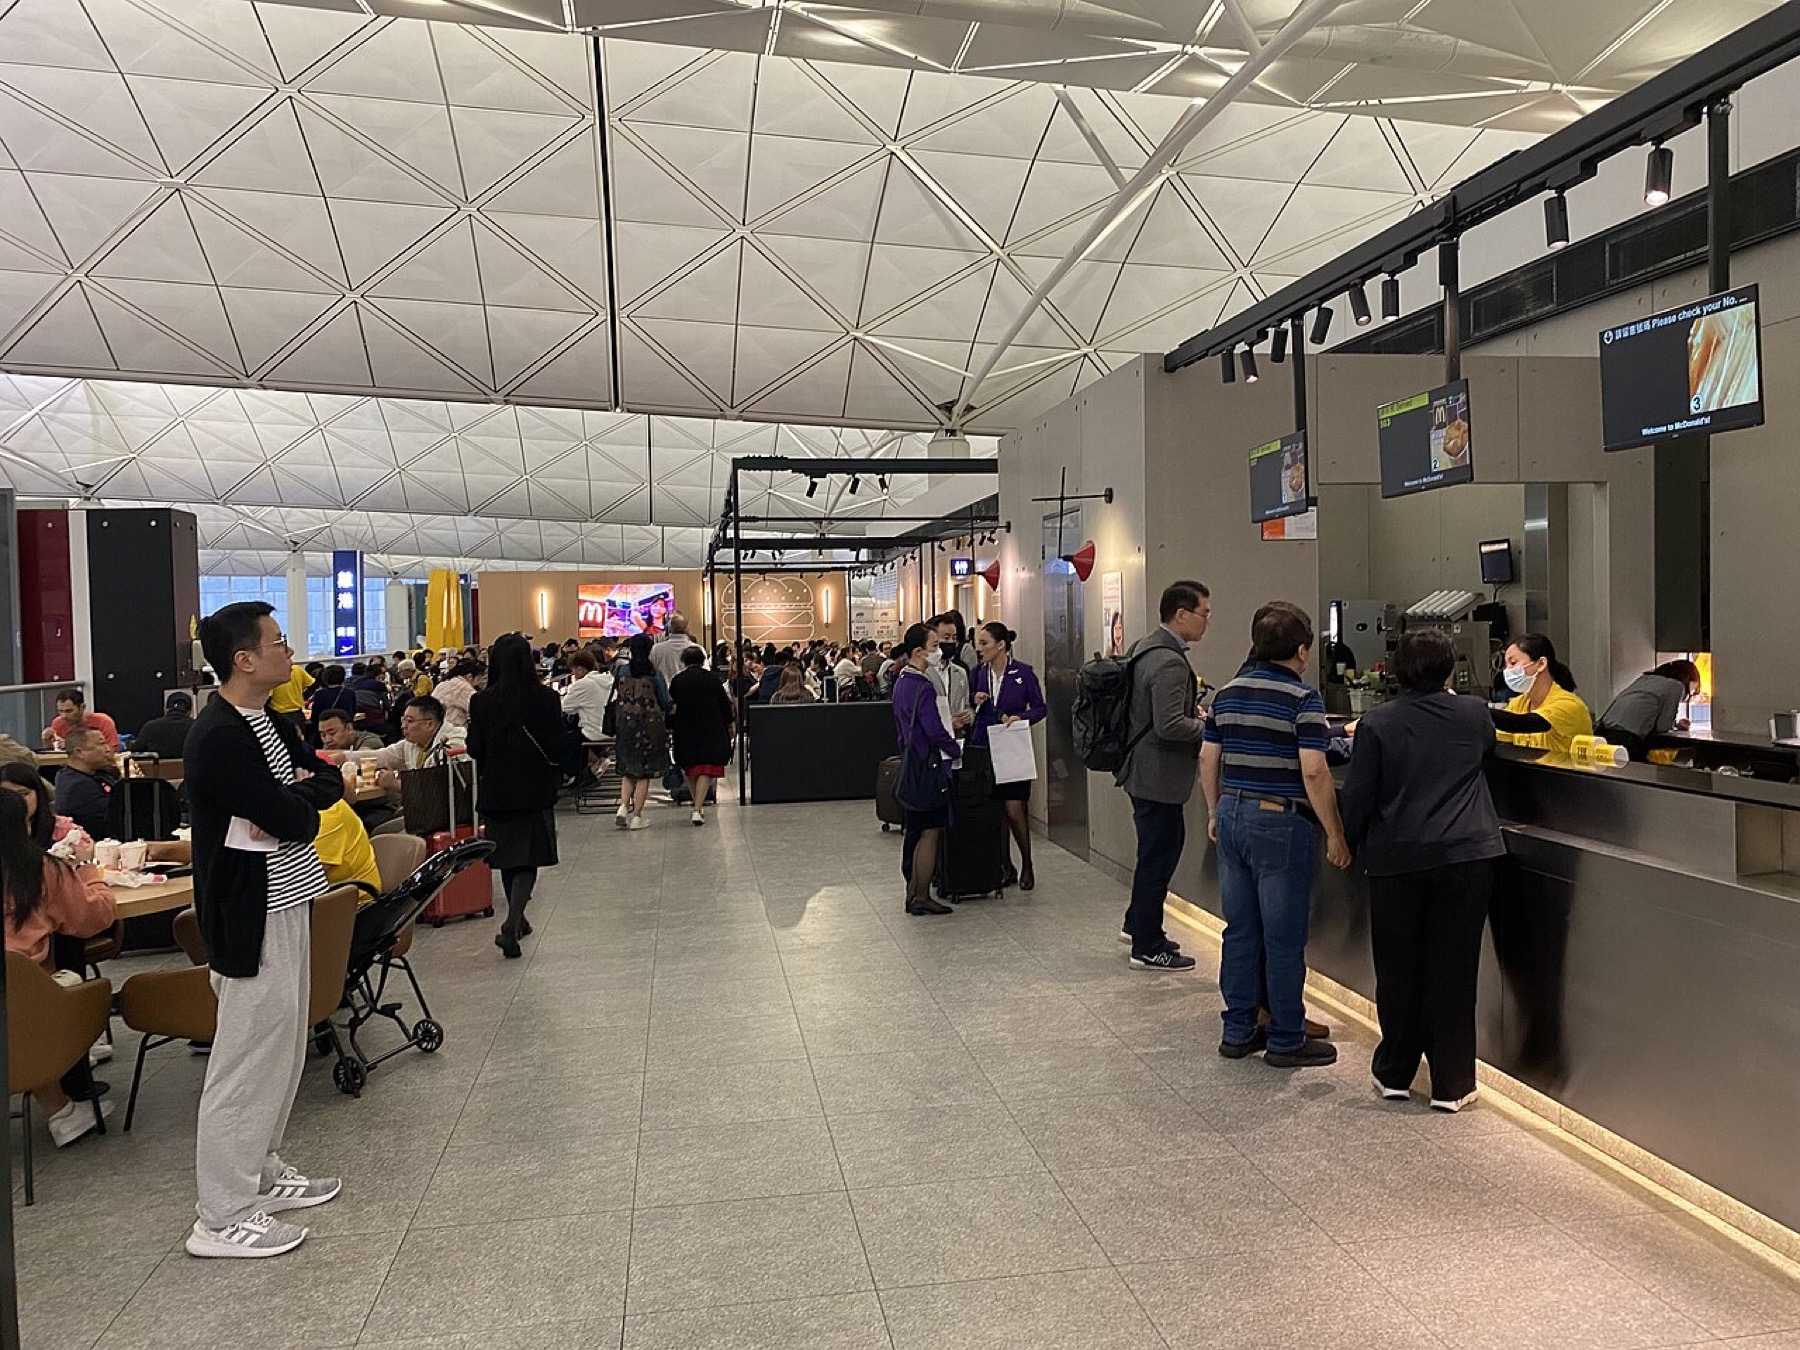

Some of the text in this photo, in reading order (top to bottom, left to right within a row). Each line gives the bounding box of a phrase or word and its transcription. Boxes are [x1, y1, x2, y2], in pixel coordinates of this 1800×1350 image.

[1651, 313, 1677, 329] Please
[1678, 305, 1701, 322] check
[1702, 300, 1722, 316] your
[1723, 295, 1738, 308] No.
[1692, 396, 1701, 411] 3
[1641, 425, 1667, 436] Welcome
[1667, 423, 1674, 431] to
